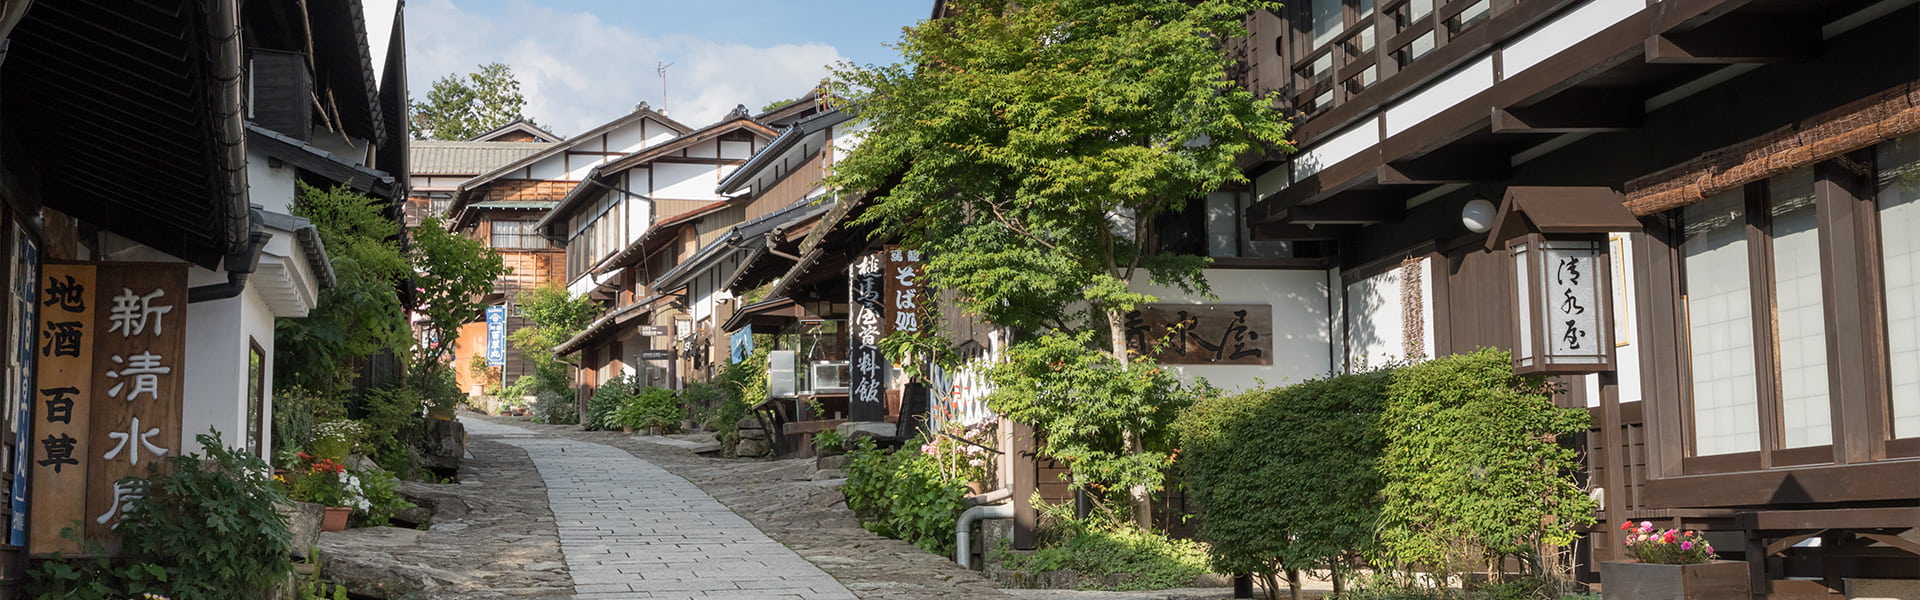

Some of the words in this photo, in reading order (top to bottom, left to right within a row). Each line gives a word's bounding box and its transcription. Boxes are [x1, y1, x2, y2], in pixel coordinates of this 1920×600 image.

[43, 275, 86, 358] 地酒
[895, 266, 918, 332] そば処
[1557, 256, 1586, 350] 清水屋
[37, 386, 79, 473] 百草
